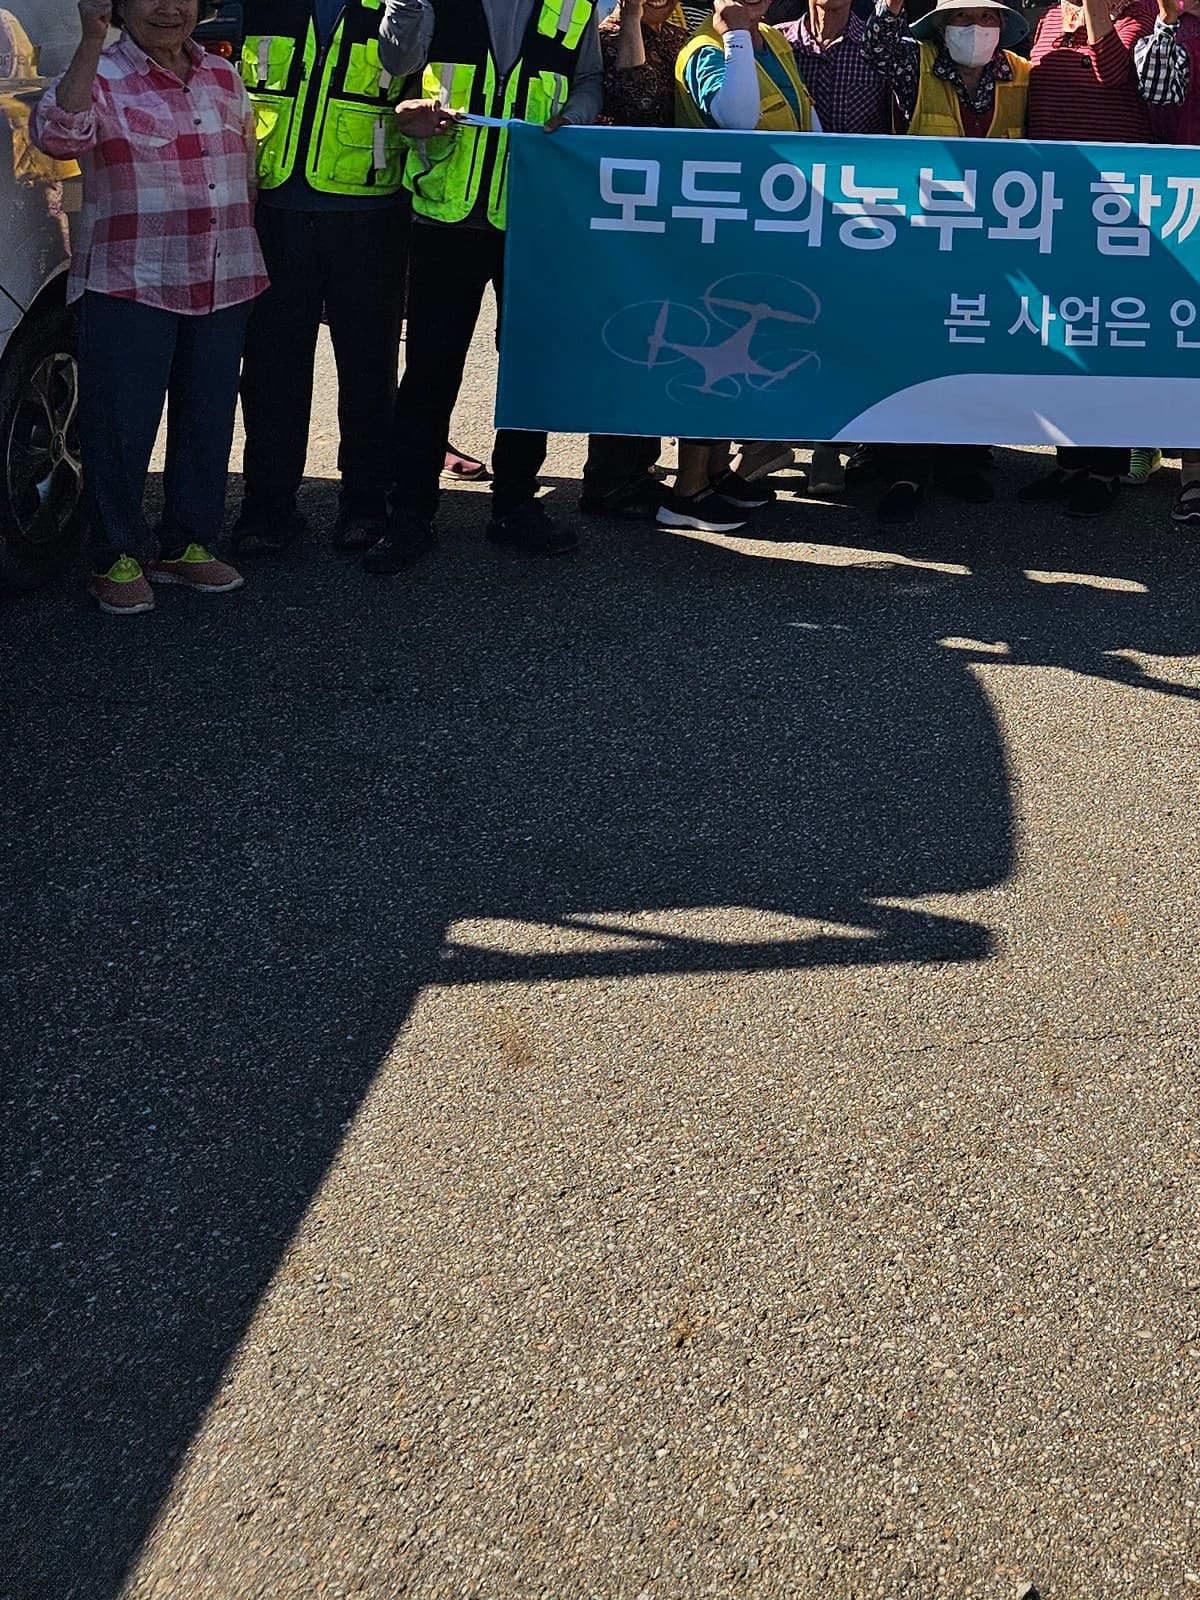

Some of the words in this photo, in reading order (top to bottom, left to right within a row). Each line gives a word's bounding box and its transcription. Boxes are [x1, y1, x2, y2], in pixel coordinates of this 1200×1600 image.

[591, 158, 1063, 253] 모두의농부와
[943, 293, 990, 343] 본
[1008, 295, 1151, 347] 사업은
